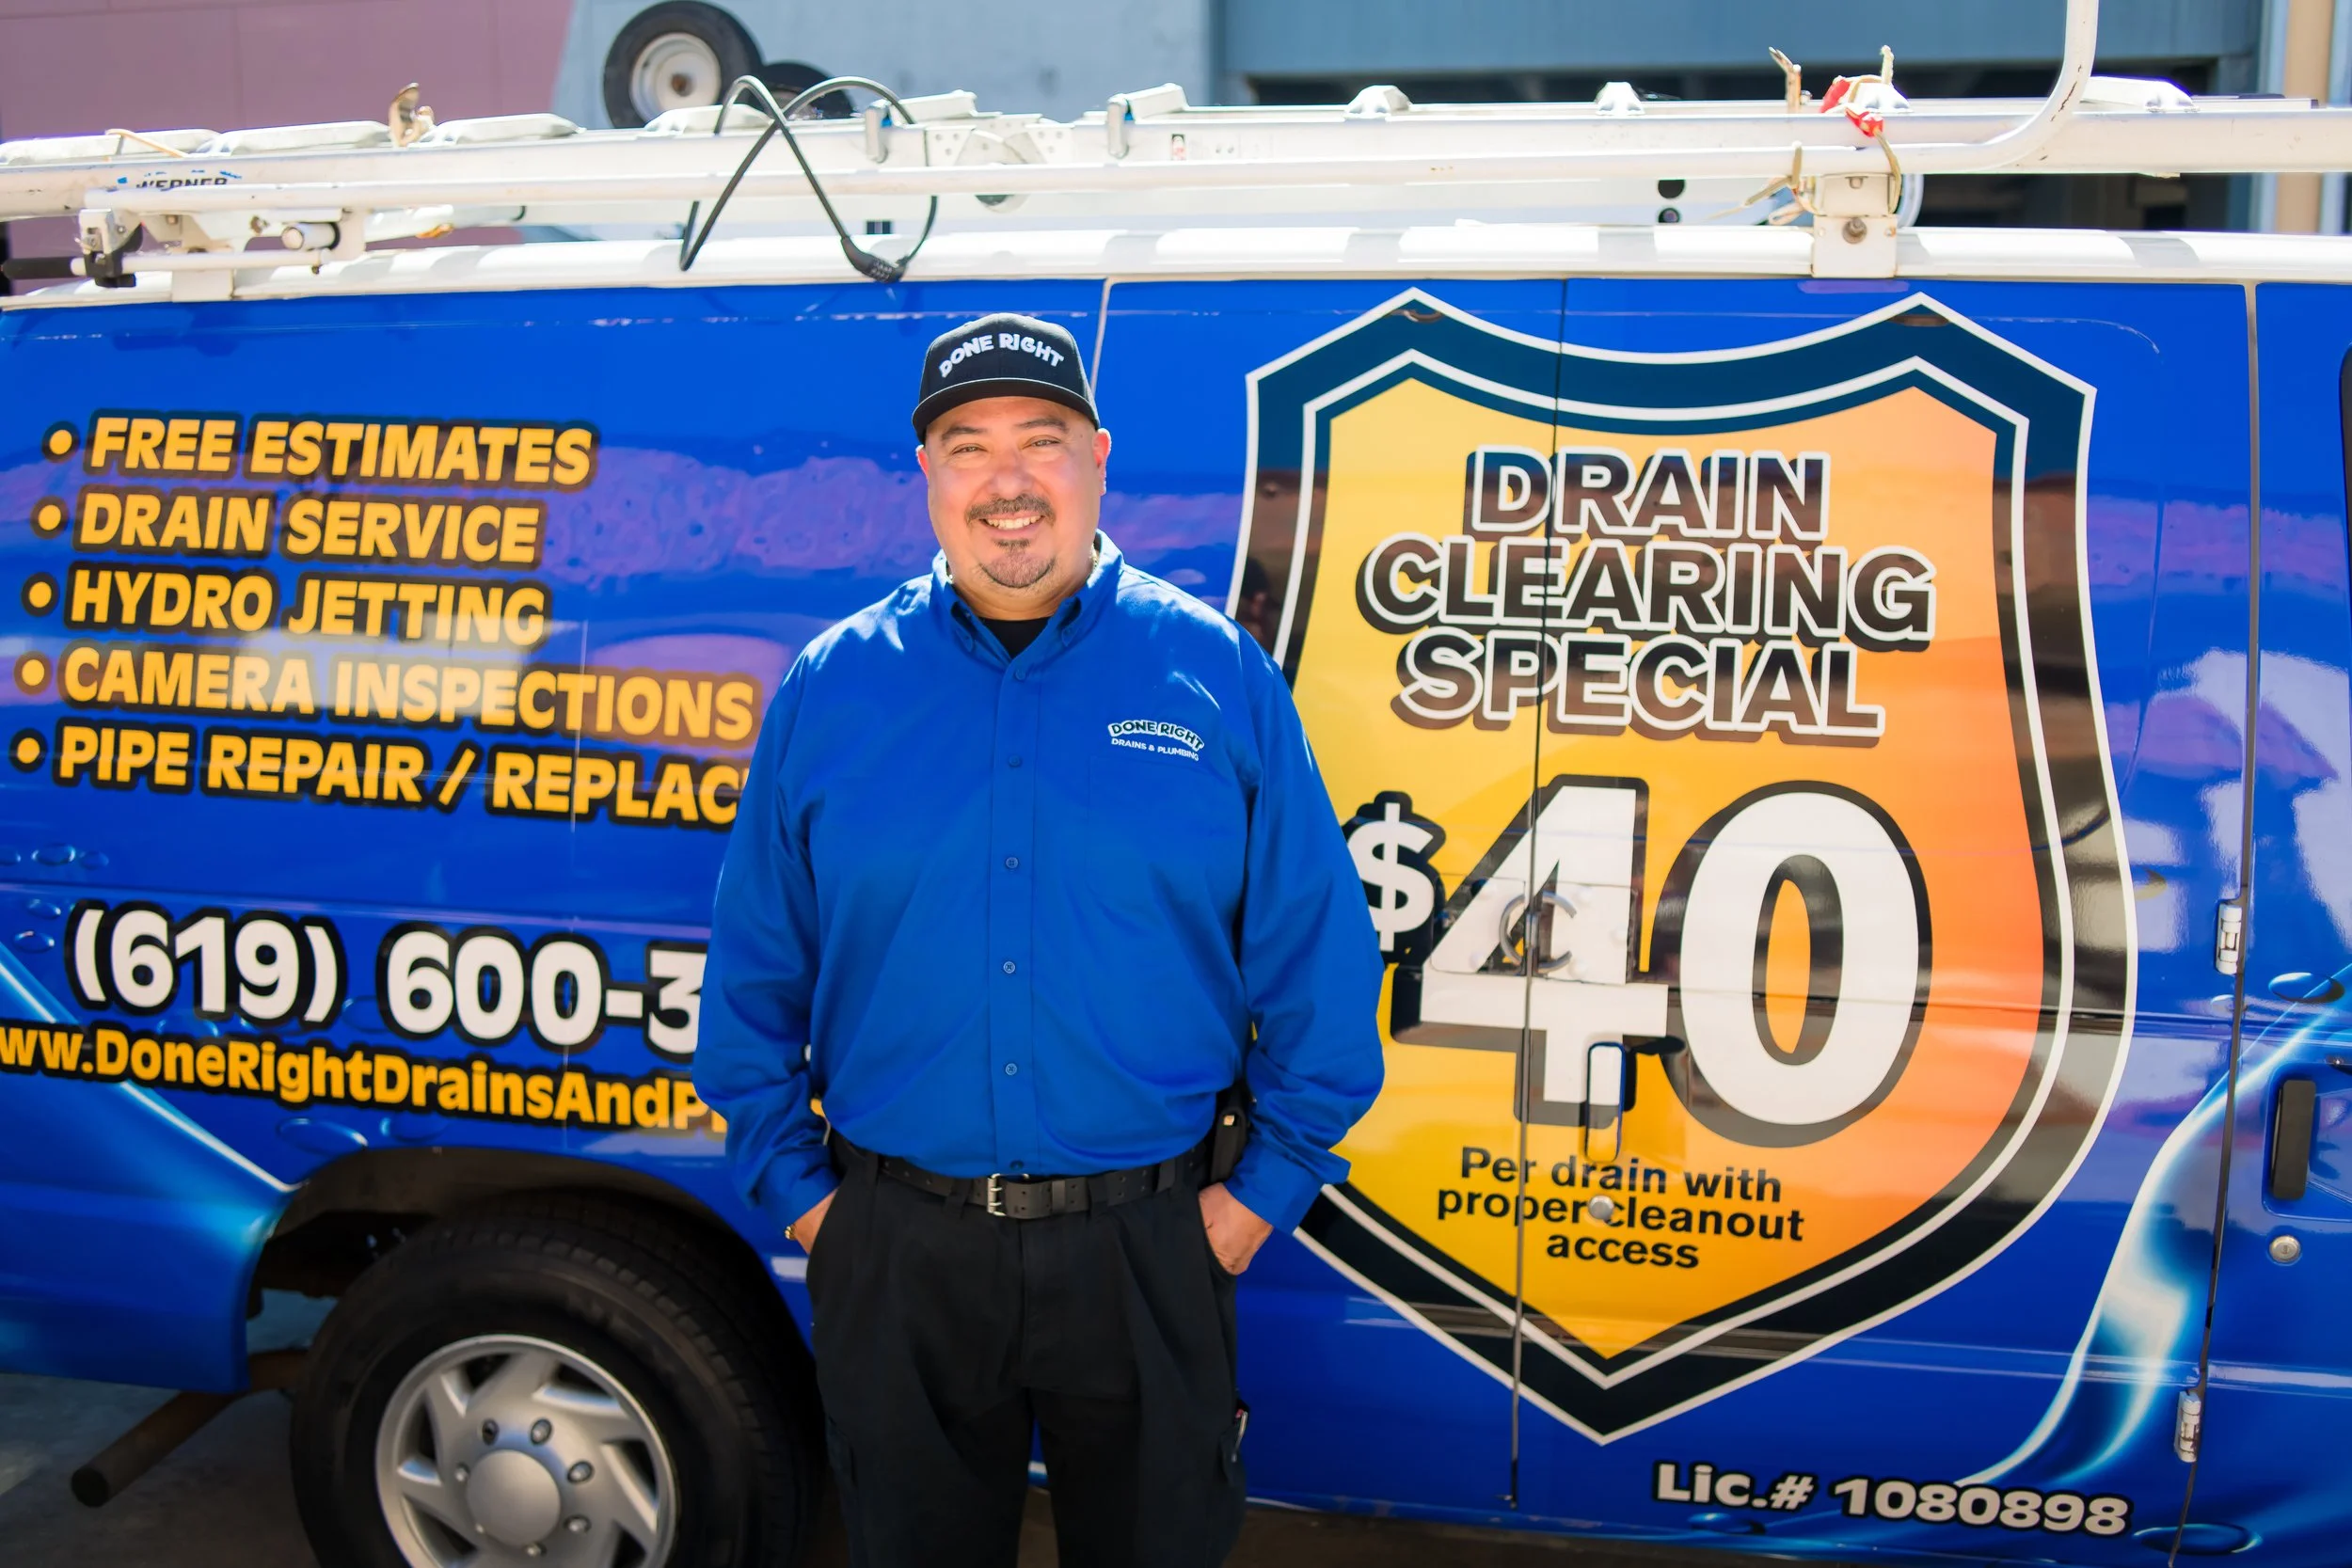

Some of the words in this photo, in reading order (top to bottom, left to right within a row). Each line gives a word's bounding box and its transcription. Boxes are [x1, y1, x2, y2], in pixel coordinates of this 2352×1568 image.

[939, 335, 994, 378] DONE
[999, 333, 1064, 367] RIGHT
[91, 416, 237, 474] FREE
[250, 420, 594, 484] ESTIMATES
[80, 492, 270, 552] DRAIN
[286, 499, 541, 564] SERVICE
[1470, 444, 1831, 543] DRAIN
[70, 568, 274, 632] HYDRO
[287, 580, 548, 646] JETTING
[1360, 531, 1937, 647] CLEARING
[63, 646, 314, 715] CAMERA
[336, 660, 754, 741] INSPECTIONS
[1394, 625, 1885, 743] SPECIAL
[1107, 720, 1157, 737] DONE
[1157, 722, 1204, 752] RIGHT
[1111, 737, 1147, 751] DRAINS
[1149, 743, 1155, 752] &
[1157, 746, 1200, 762] PLUMBING
[59, 725, 191, 786] PIPE
[207, 735, 424, 803] REPAIR
[493, 752, 750, 824] REPLAC
[73, 908, 340, 1022] (619)
[1438, 1188, 1587, 1227] proper
[1461, 1146, 1537, 1184] Per
[1551, 1155, 1667, 1194] drain
[1684, 1166, 1781, 1202] with
[1547, 1233, 1699, 1268] access
[1657, 1462, 1814, 1511] Lic.#
[1835, 1479, 2130, 1537] 1080898
